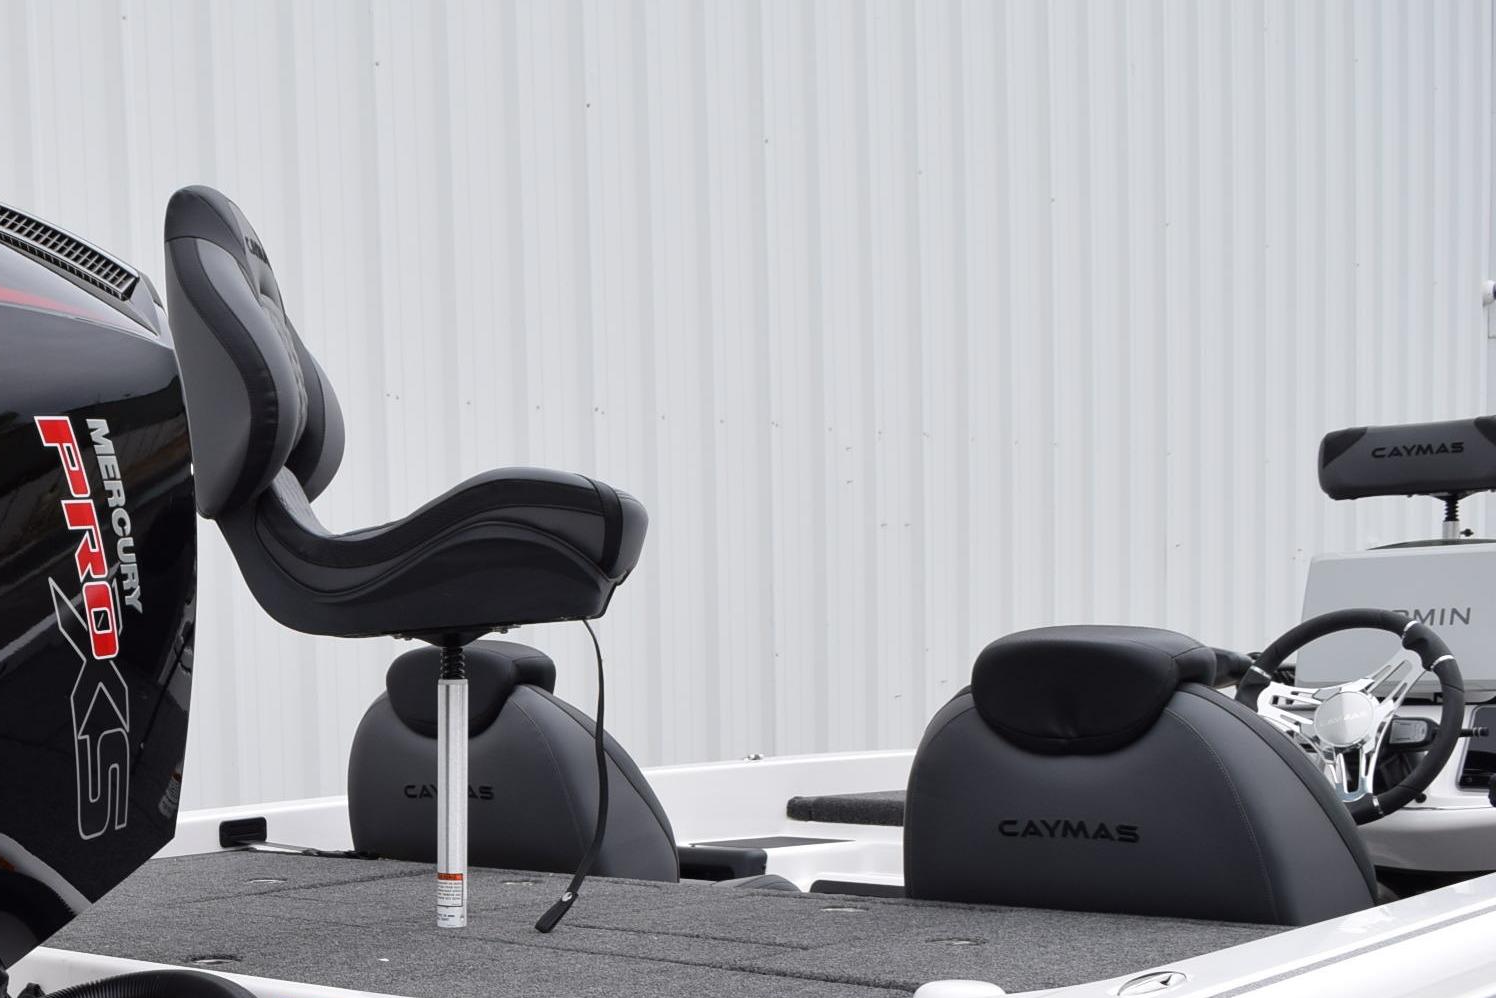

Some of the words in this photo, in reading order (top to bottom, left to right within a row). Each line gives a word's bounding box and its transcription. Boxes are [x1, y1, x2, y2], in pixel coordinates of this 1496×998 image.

[1371, 441, 1465, 459] CAYMAS
[33, 416, 119, 660] PRO
[86, 418, 143, 614] MERCURY
[998, 819, 1140, 843] CAYMAS
